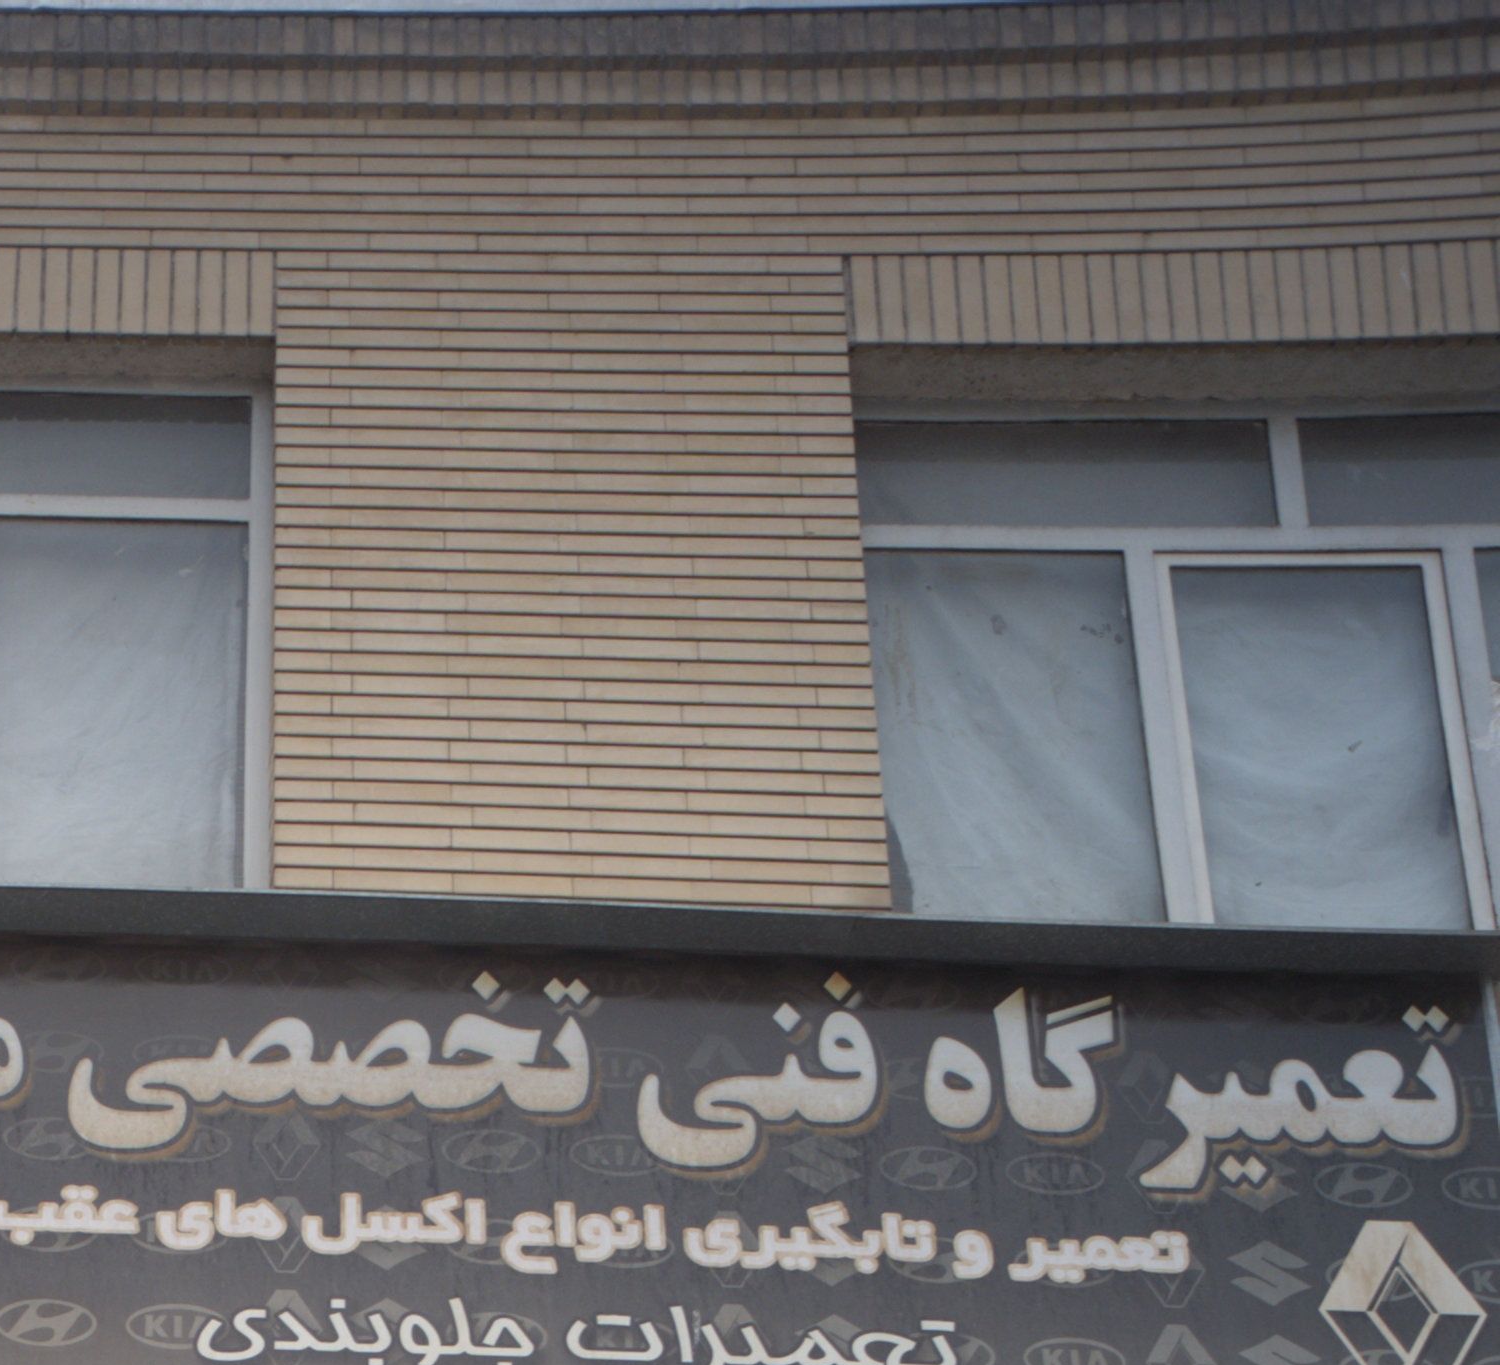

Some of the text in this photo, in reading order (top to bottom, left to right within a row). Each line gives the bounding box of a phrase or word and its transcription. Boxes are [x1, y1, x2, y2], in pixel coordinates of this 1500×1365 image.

[68, 970, 591, 1150] تخصصی
[637, 971, 879, 1168] فنی
[925, 986, 1115, 1133] گاه
[1138, 1004, 1460, 1188] تعمیر
[155, 1188, 287, 1251] های
[301, 1191, 488, 1254] اکسل
[500, 1200, 667, 1275] انواع
[683, 1201, 936, 1275] تابگیری
[952, 1229, 994, 1279] و
[1008, 1230, 1189, 1284] تعمیر
